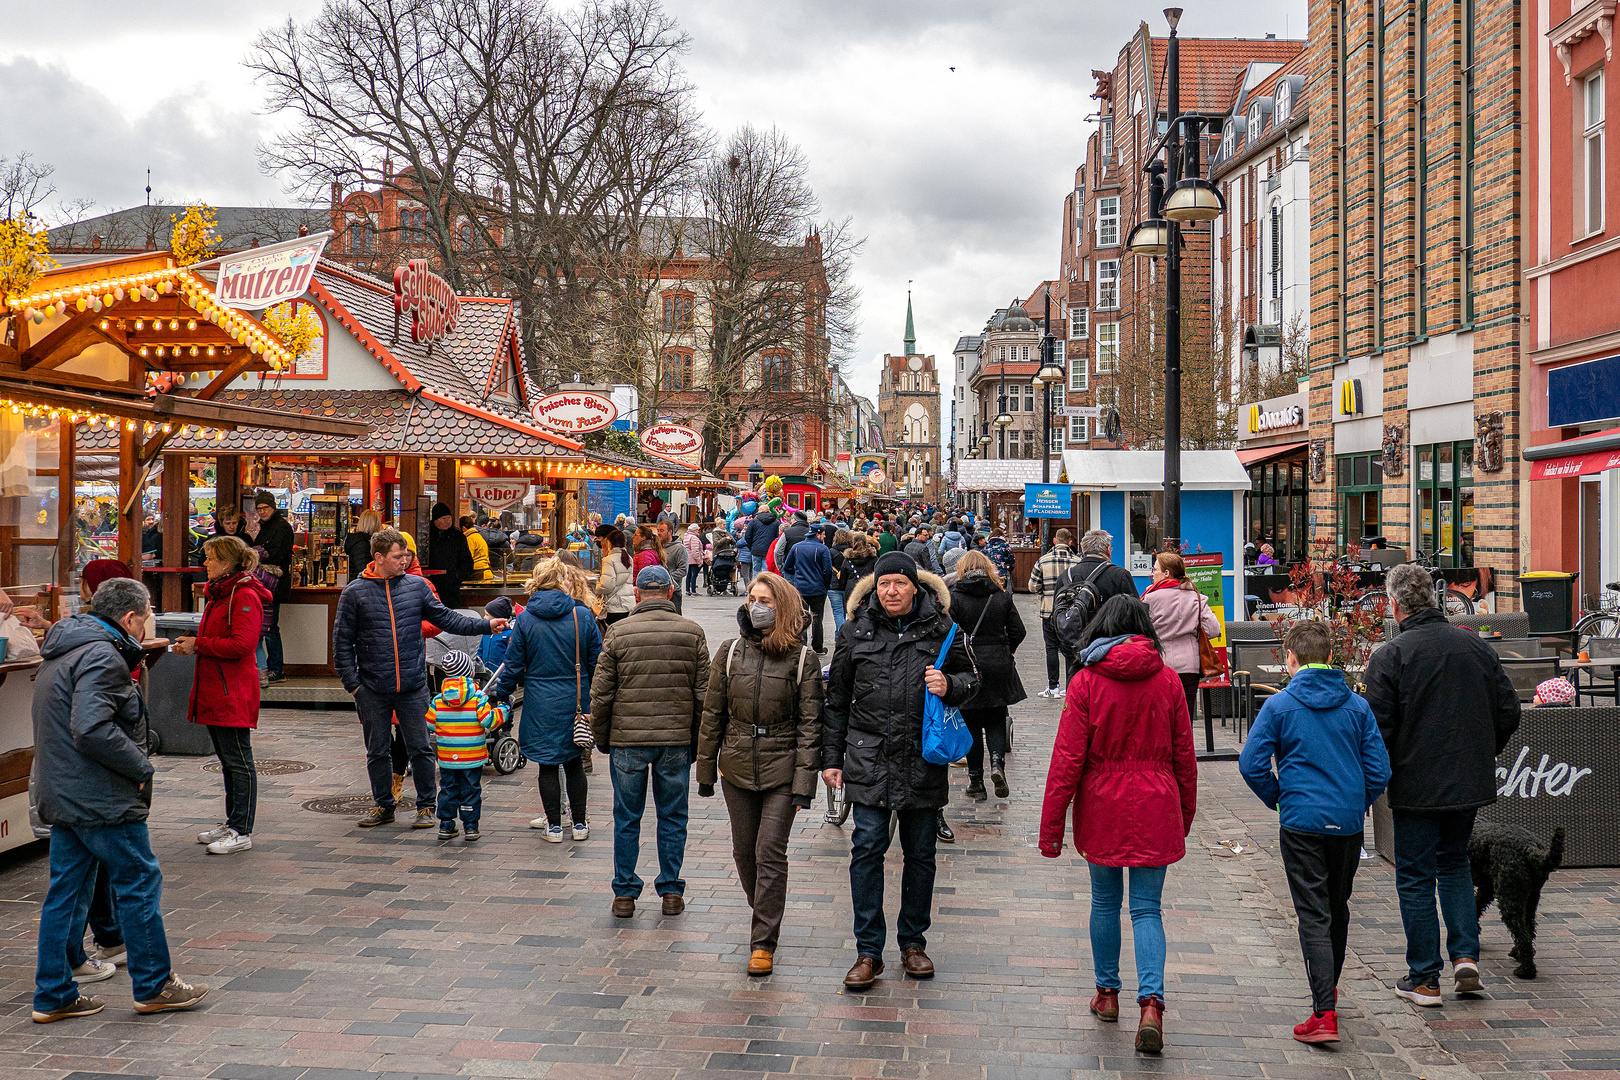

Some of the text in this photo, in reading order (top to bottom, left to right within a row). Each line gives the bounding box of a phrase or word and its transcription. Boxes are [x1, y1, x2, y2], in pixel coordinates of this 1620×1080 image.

[220, 264, 311, 299] Mutzen
[401, 261, 461, 326] Schlemmer
[419, 298, 446, 340] Stube
[548, 415, 603, 428] vom Fass
[583, 396, 609, 414] Bier
[475, 487, 520, 500] Leber
[1495, 745, 1593, 798] chter
